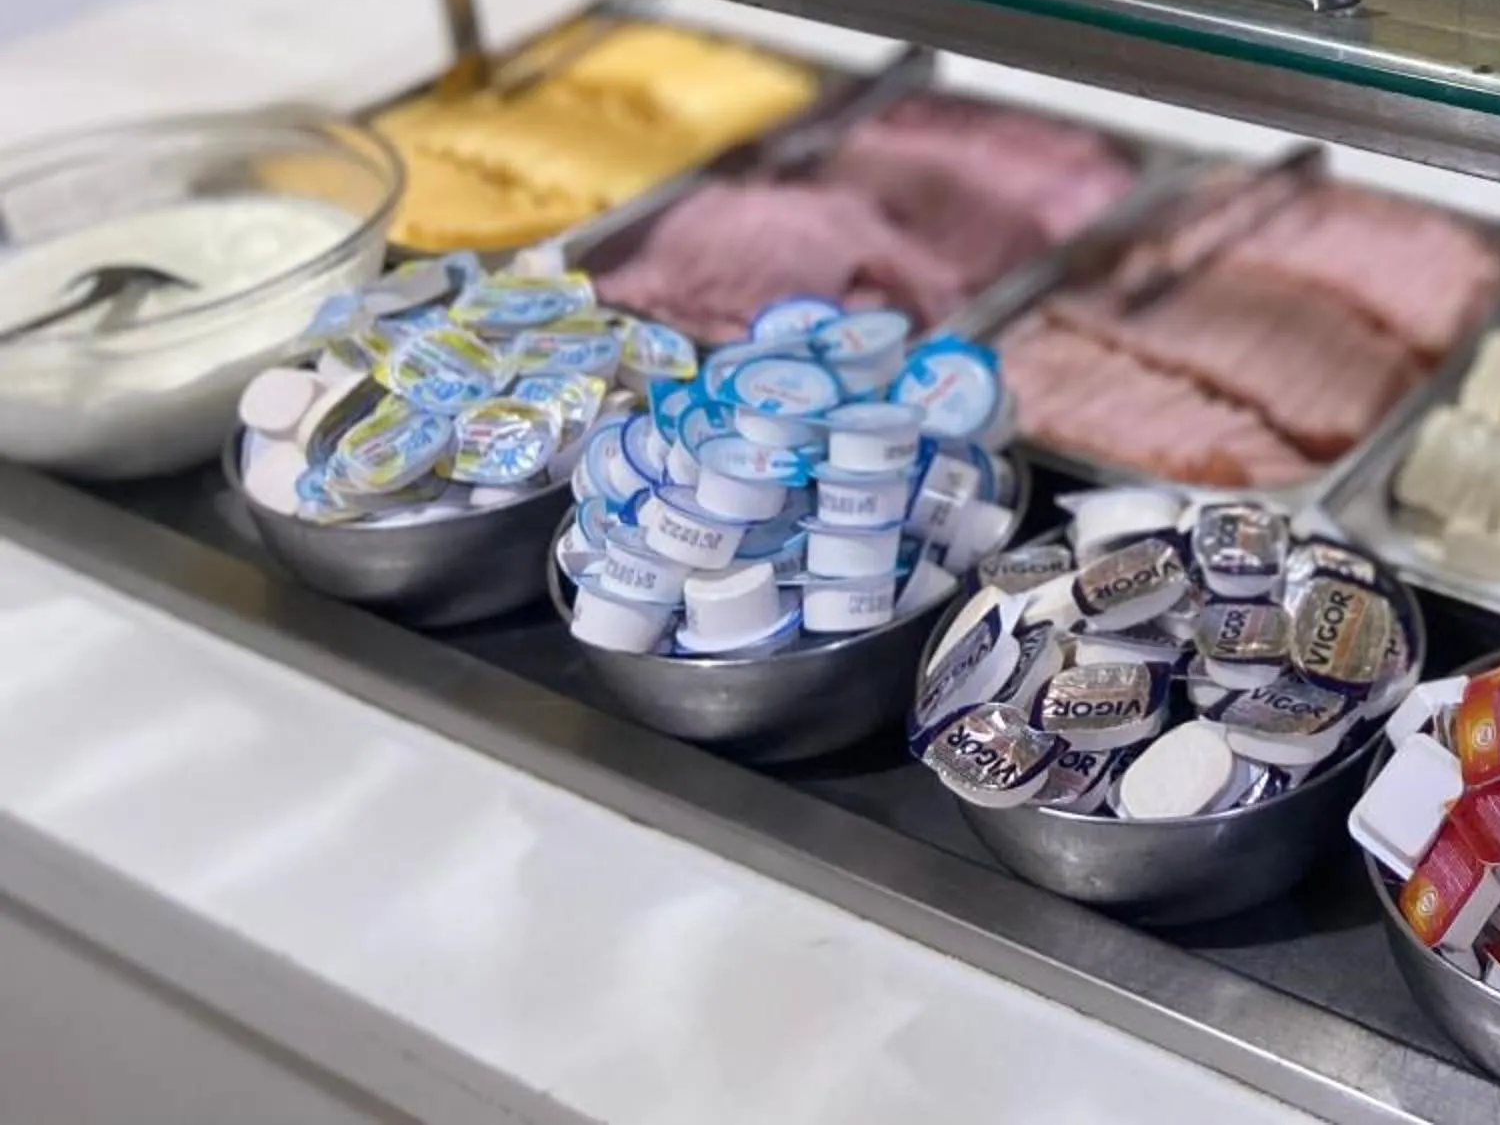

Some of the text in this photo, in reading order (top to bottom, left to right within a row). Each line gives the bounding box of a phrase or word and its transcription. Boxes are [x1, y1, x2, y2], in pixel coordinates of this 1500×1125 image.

[1214, 610, 1250, 655] VIGOR
[1305, 589, 1353, 666] VIGOR
[1054, 698, 1142, 719] VIGOR
[1251, 686, 1329, 719] VIGOR
[947, 725, 1018, 785] VIGOR
